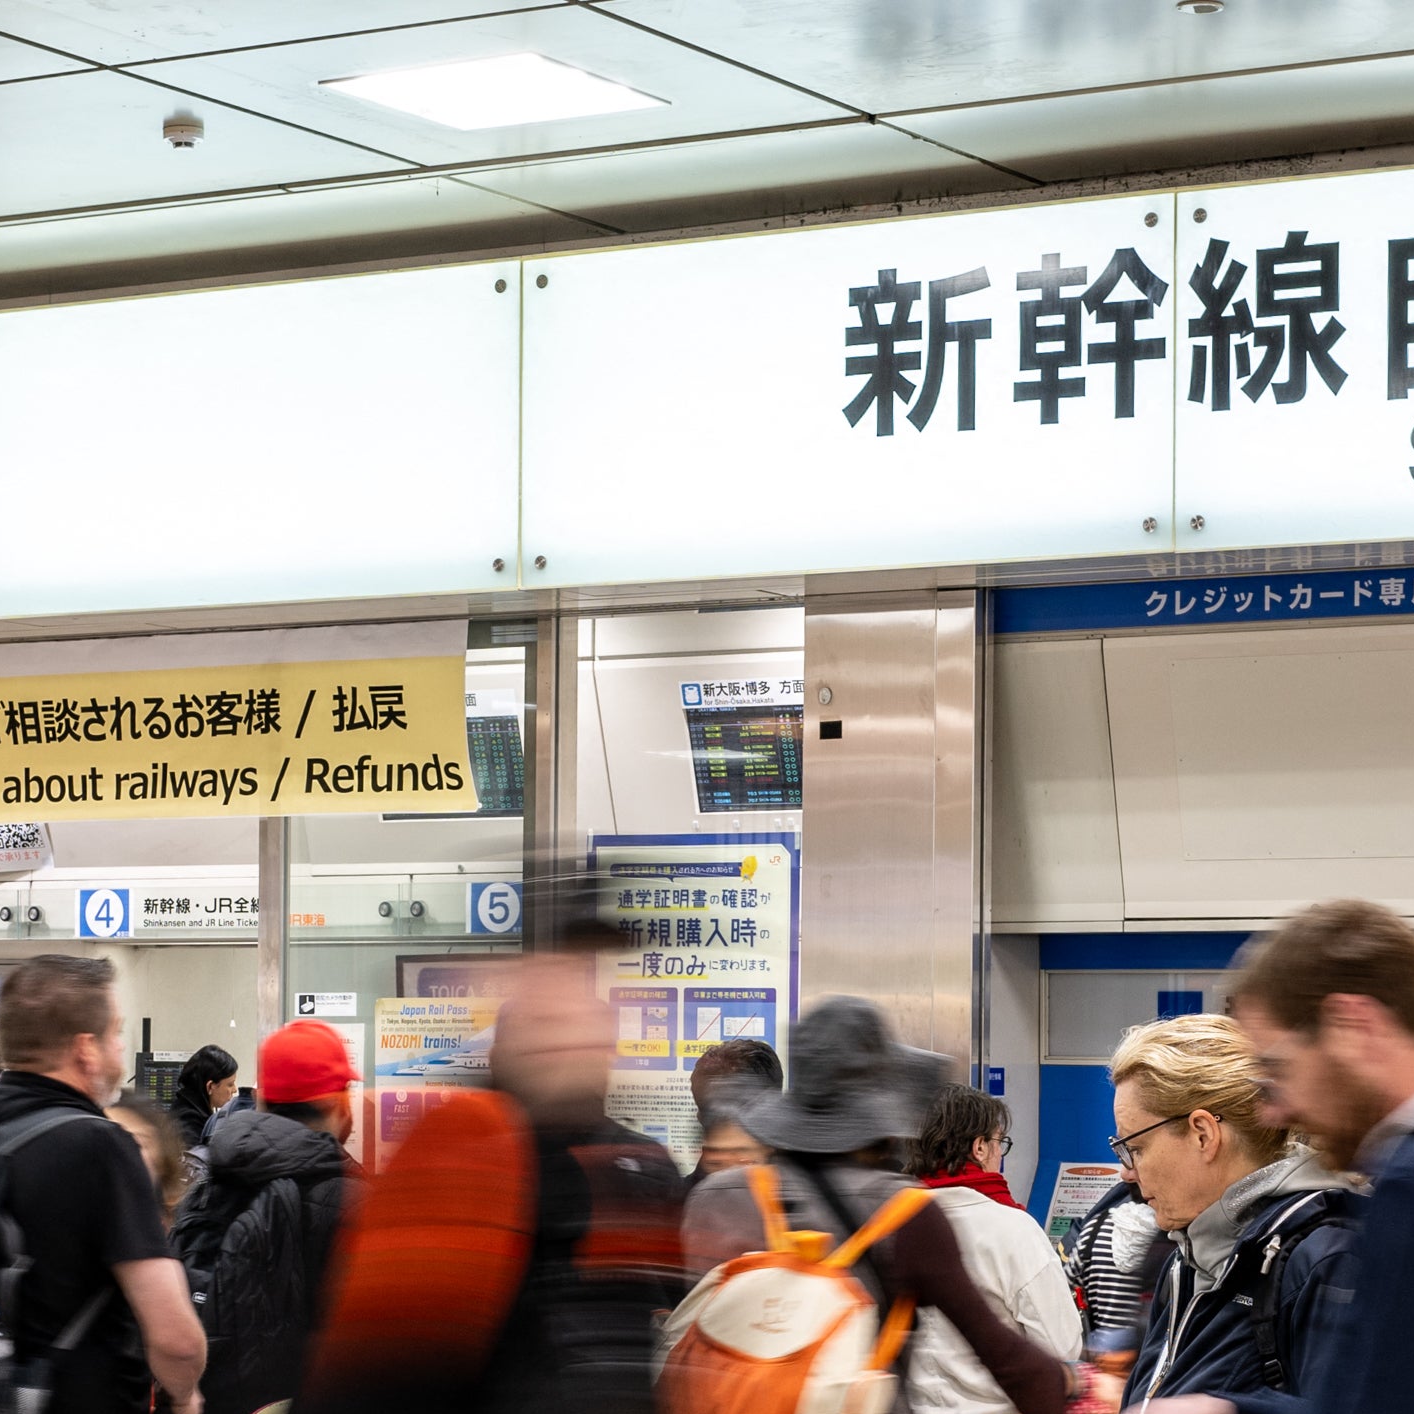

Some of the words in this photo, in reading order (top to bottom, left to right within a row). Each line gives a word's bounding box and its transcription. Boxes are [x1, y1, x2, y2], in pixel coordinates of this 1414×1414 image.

[332, 685, 408, 733] 払戻
[2, 766, 103, 804] about
[114, 763, 259, 806] railways
[304, 753, 465, 794] Refunds
[488, 892, 509, 924] 5
[617, 888, 771, 909] 通学証明書の確認が
[94, 898, 114, 928] 4
[189, 918, 203, 927] and
[205, 918, 216, 927] JR
[218, 917, 235, 927] Line
[236, 917, 258, 927] Ticke
[617, 917, 770, 948] 新規購入時の
[617, 952, 771, 978] 一度のみに変わります。
[400, 1004, 426, 1017] Japan
[428, 1004, 445, 1015] Rail
[447, 1004, 468, 1015] Pass
[381, 1034, 421, 1049] NOZOMI
[424, 1034, 462, 1049] trains!
